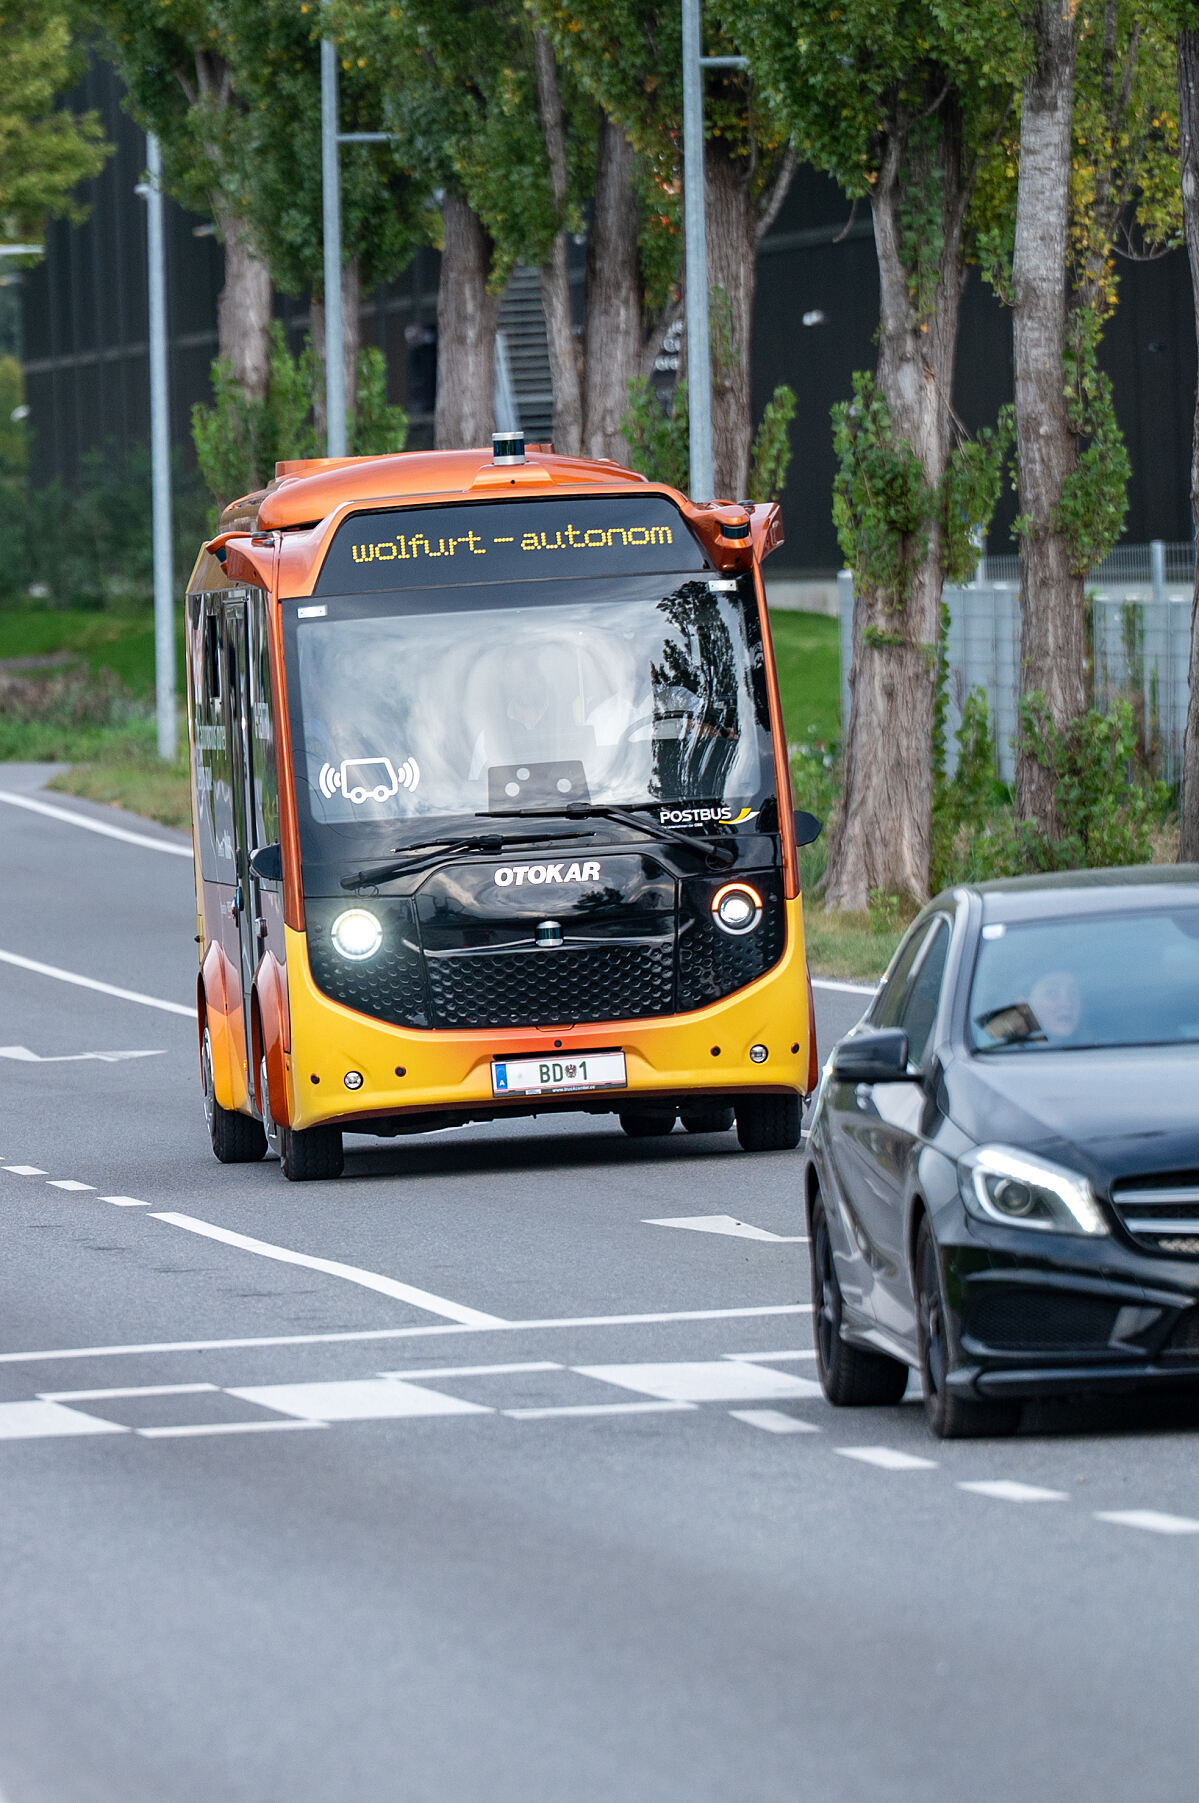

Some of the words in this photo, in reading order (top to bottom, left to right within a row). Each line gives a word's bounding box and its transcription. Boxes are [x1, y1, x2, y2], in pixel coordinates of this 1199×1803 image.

[352, 530, 486, 563] wolfurt
[520, 524, 673, 550] autonom
[660, 806, 732, 824] POSTBUS
[494, 861, 601, 887] OTOKAR
[539, 1063, 564, 1083] BD
[579, 1061, 588, 1081] 1
